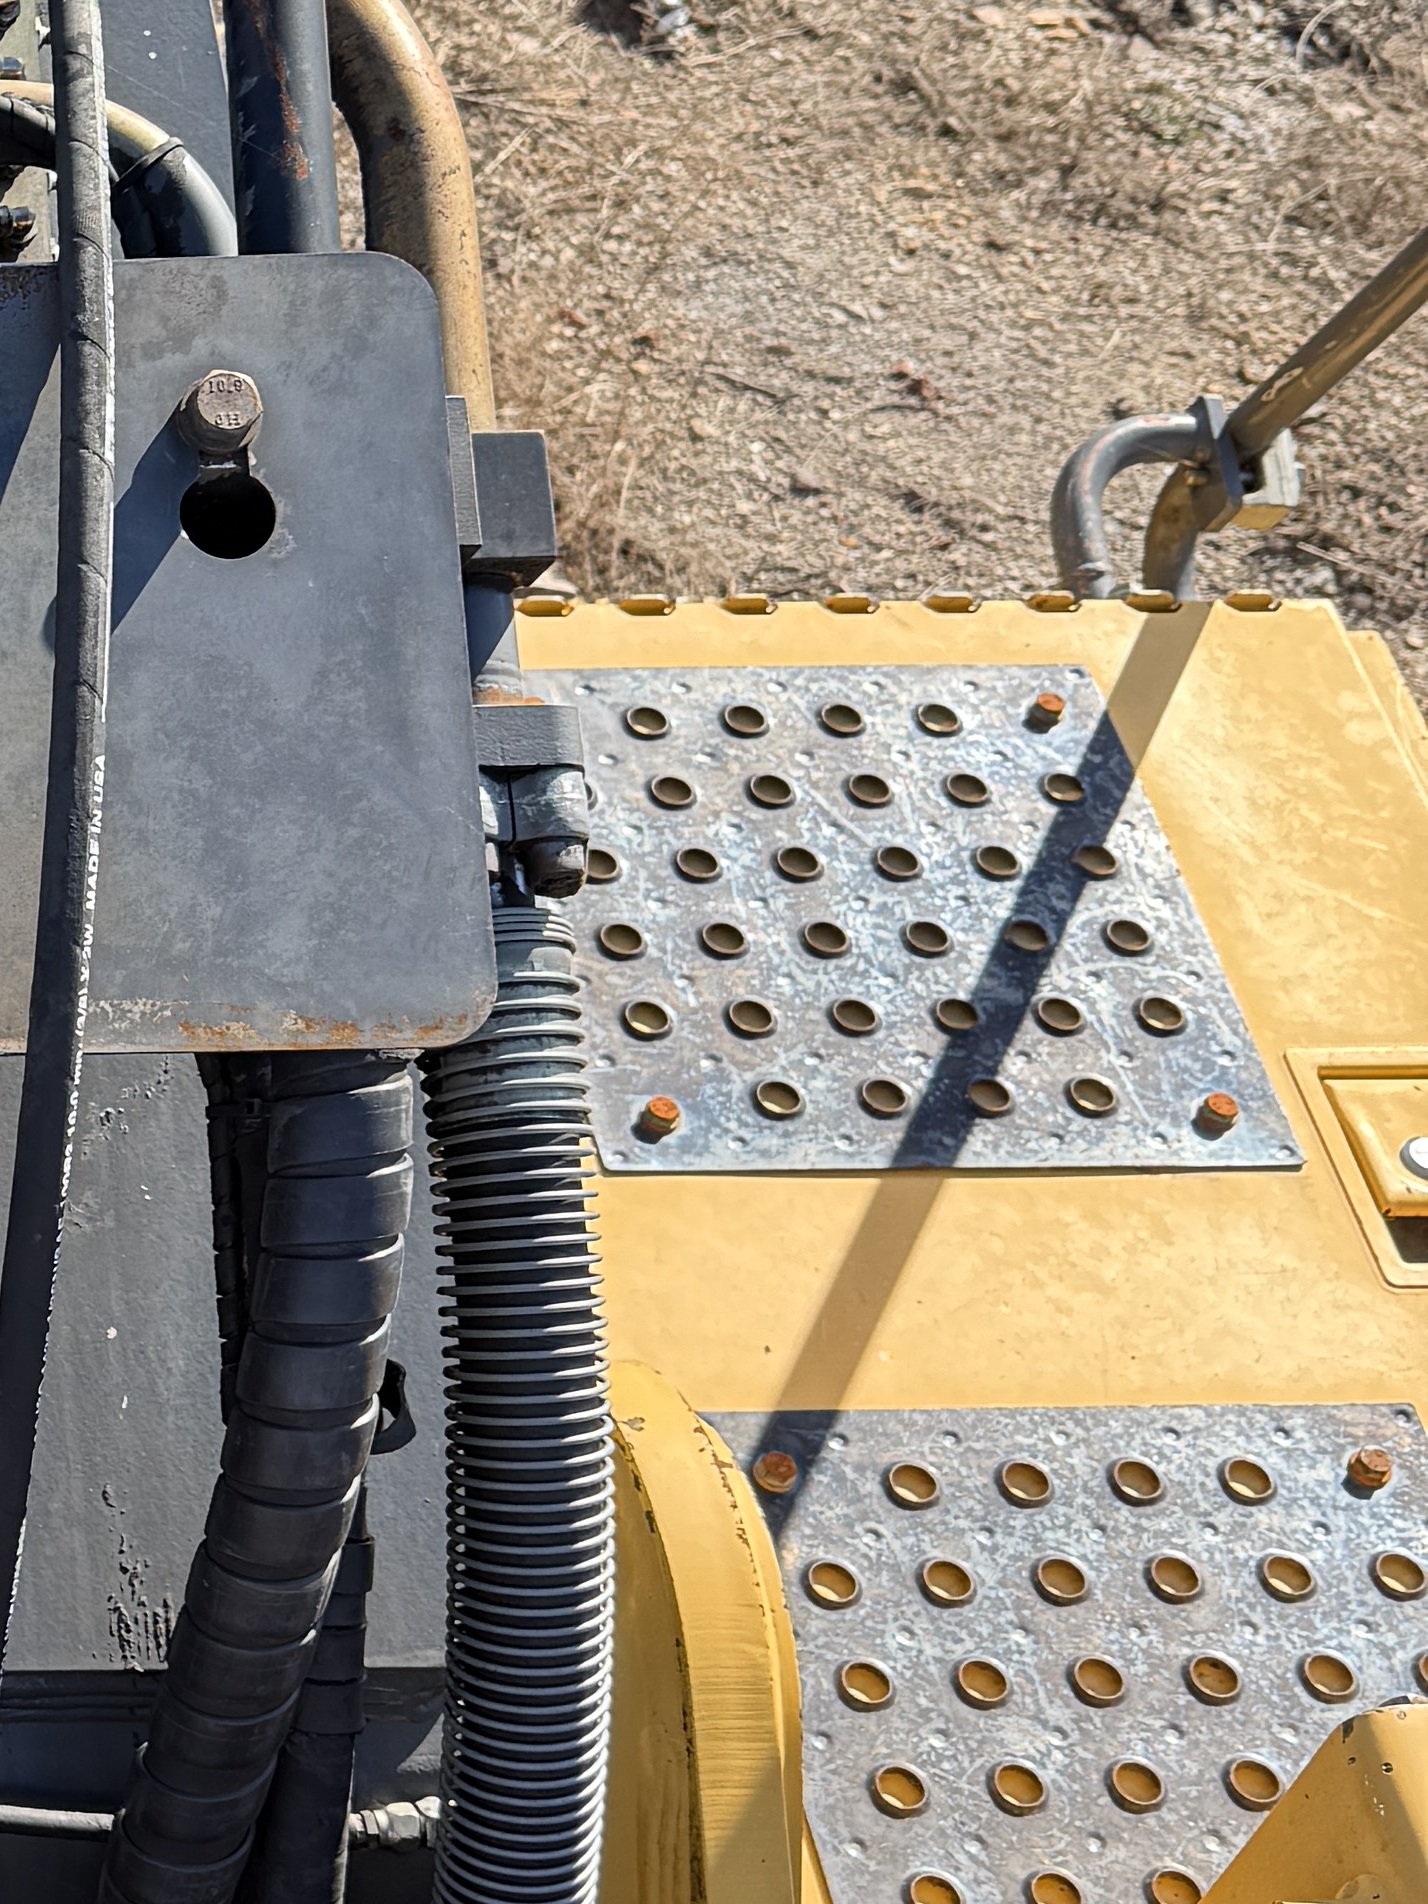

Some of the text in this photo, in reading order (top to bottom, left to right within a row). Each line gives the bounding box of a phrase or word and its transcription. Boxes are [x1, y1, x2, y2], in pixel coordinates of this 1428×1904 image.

[92, 753, 106, 803] USA
[90, 808, 103, 834] IN
[85, 838, 100, 911] MADE
